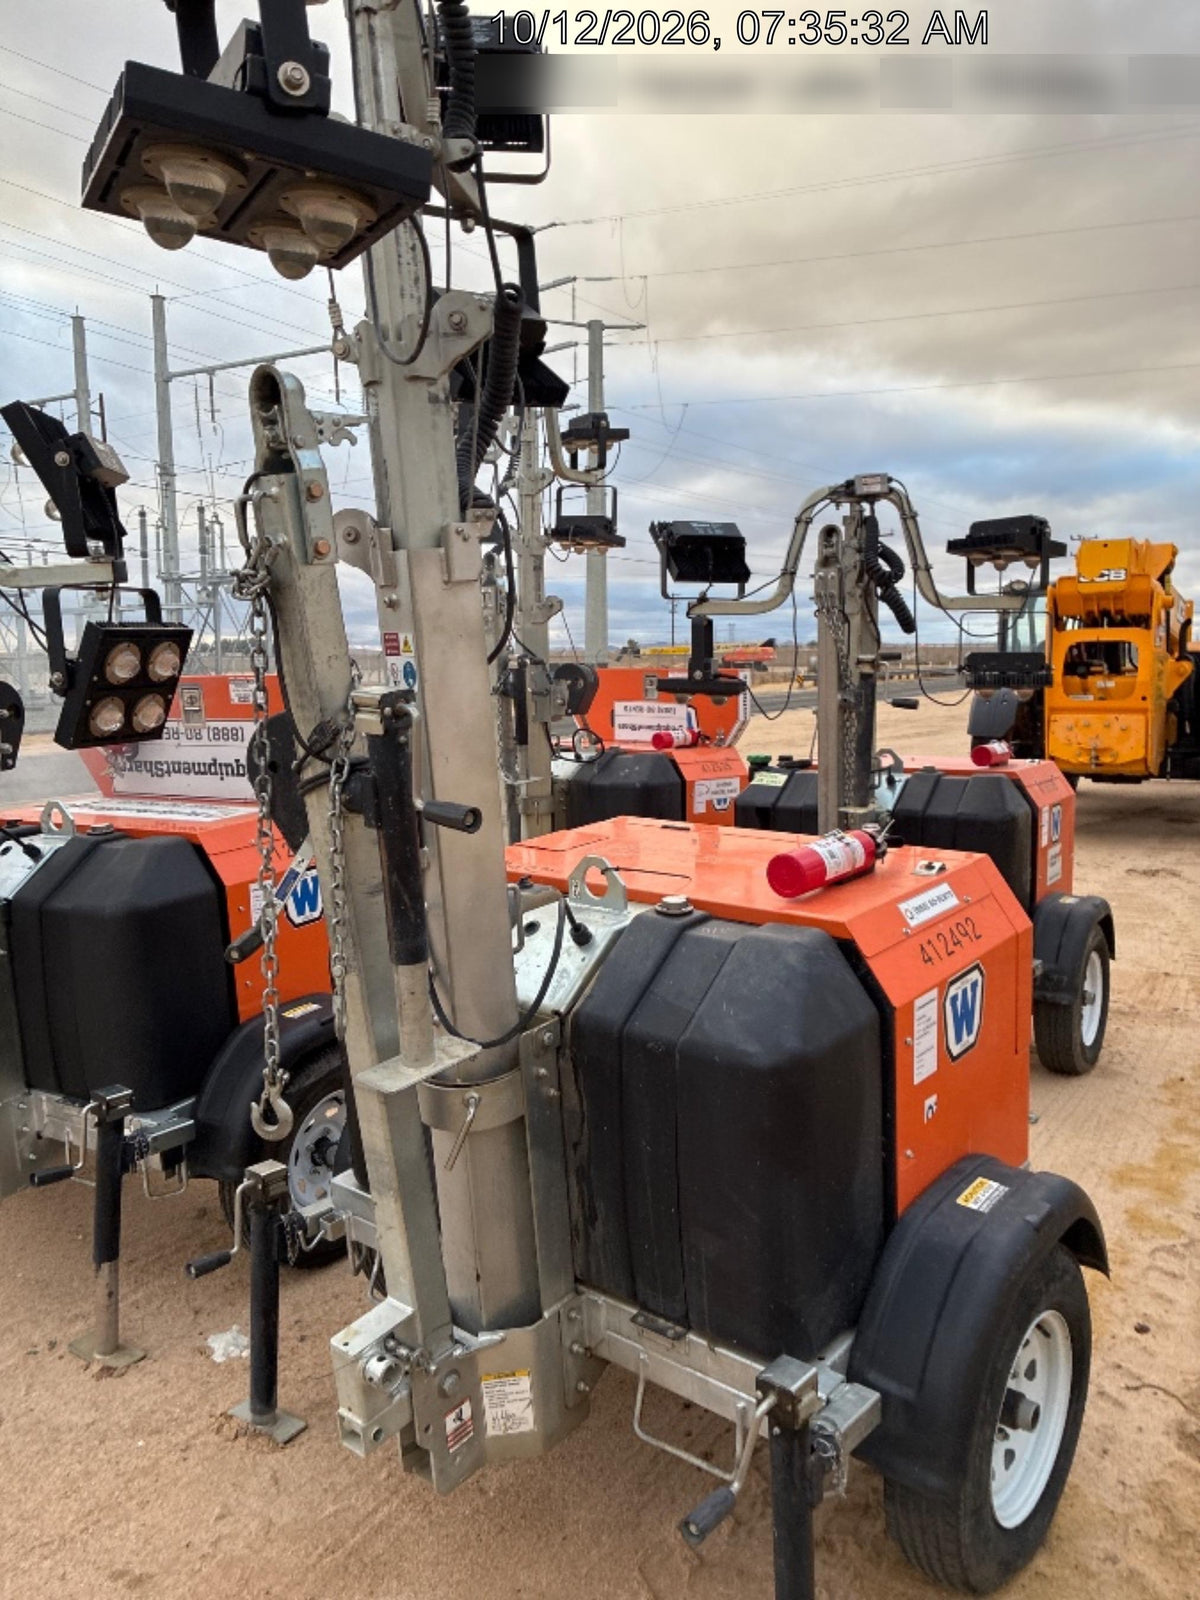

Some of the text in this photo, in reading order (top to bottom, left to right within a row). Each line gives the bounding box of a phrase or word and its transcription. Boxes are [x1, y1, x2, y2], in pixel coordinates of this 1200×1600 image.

[207, 726, 245, 742] (888)
[121, 757, 246, 781] quipmentShar
[918, 916, 983, 966] 412492
[949, 978, 979, 1046] W
